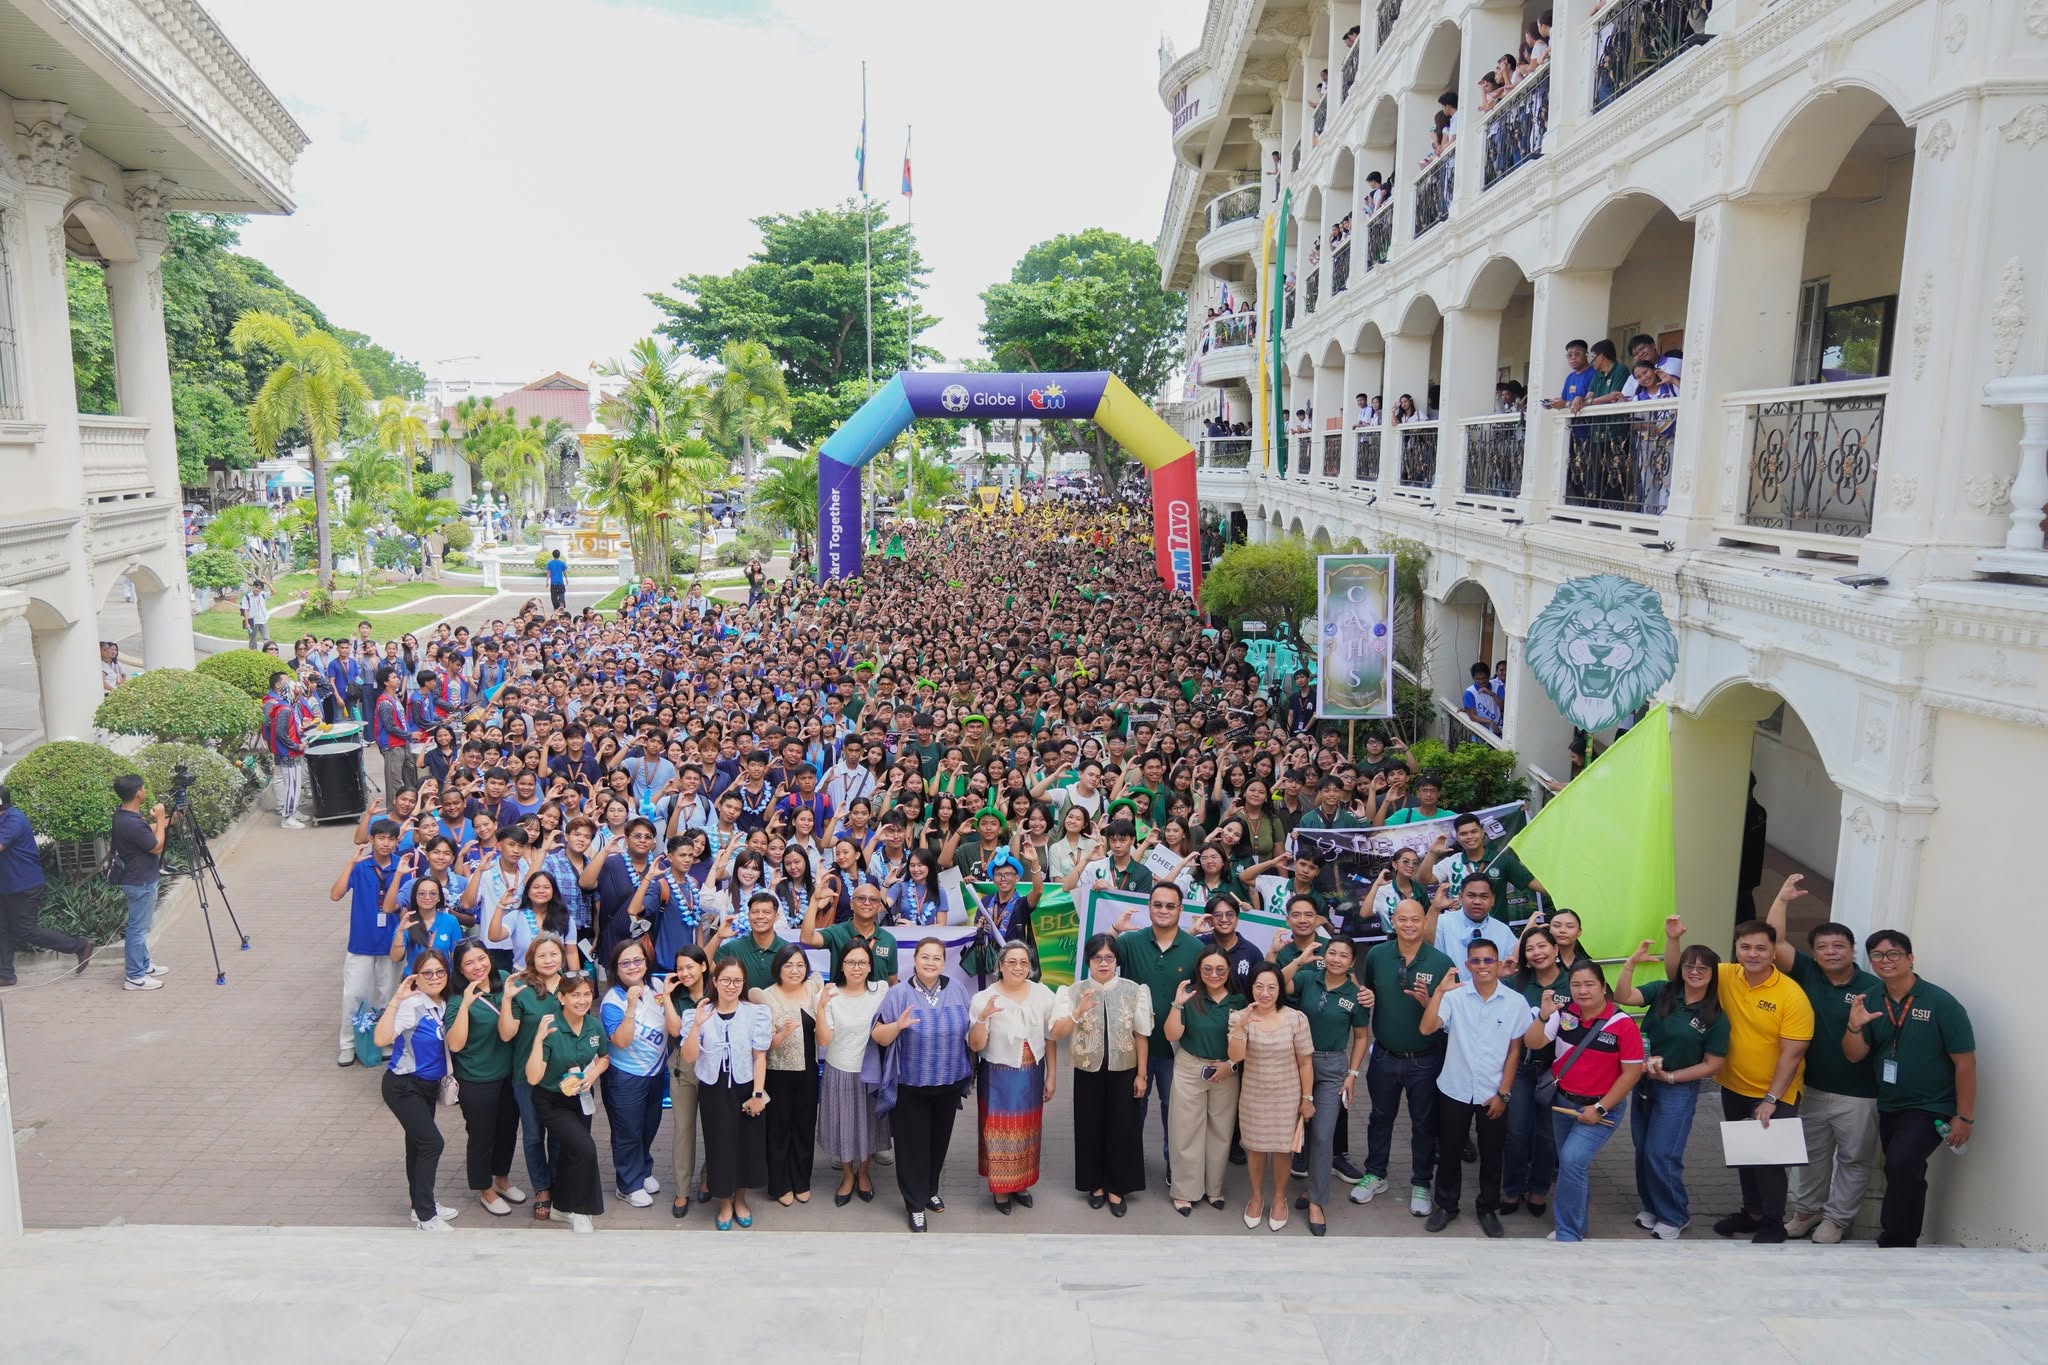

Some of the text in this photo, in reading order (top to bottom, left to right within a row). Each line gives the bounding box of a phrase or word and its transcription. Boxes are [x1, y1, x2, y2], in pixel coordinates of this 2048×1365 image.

[973, 393, 1016, 406] Globe
[1028, 389, 1066, 409] tm
[828, 488, 843, 549] Together
[875, 946, 889, 955] CSU
[1316, 960, 1326, 968] CS
[1415, 972, 1433, 982] CSU
[1339, 997, 1355, 1009] CSU
[1845, 993, 1857, 1002] CS
[1912, 1008, 1931, 1019] CSU
[636, 1021, 664, 1046] TED
